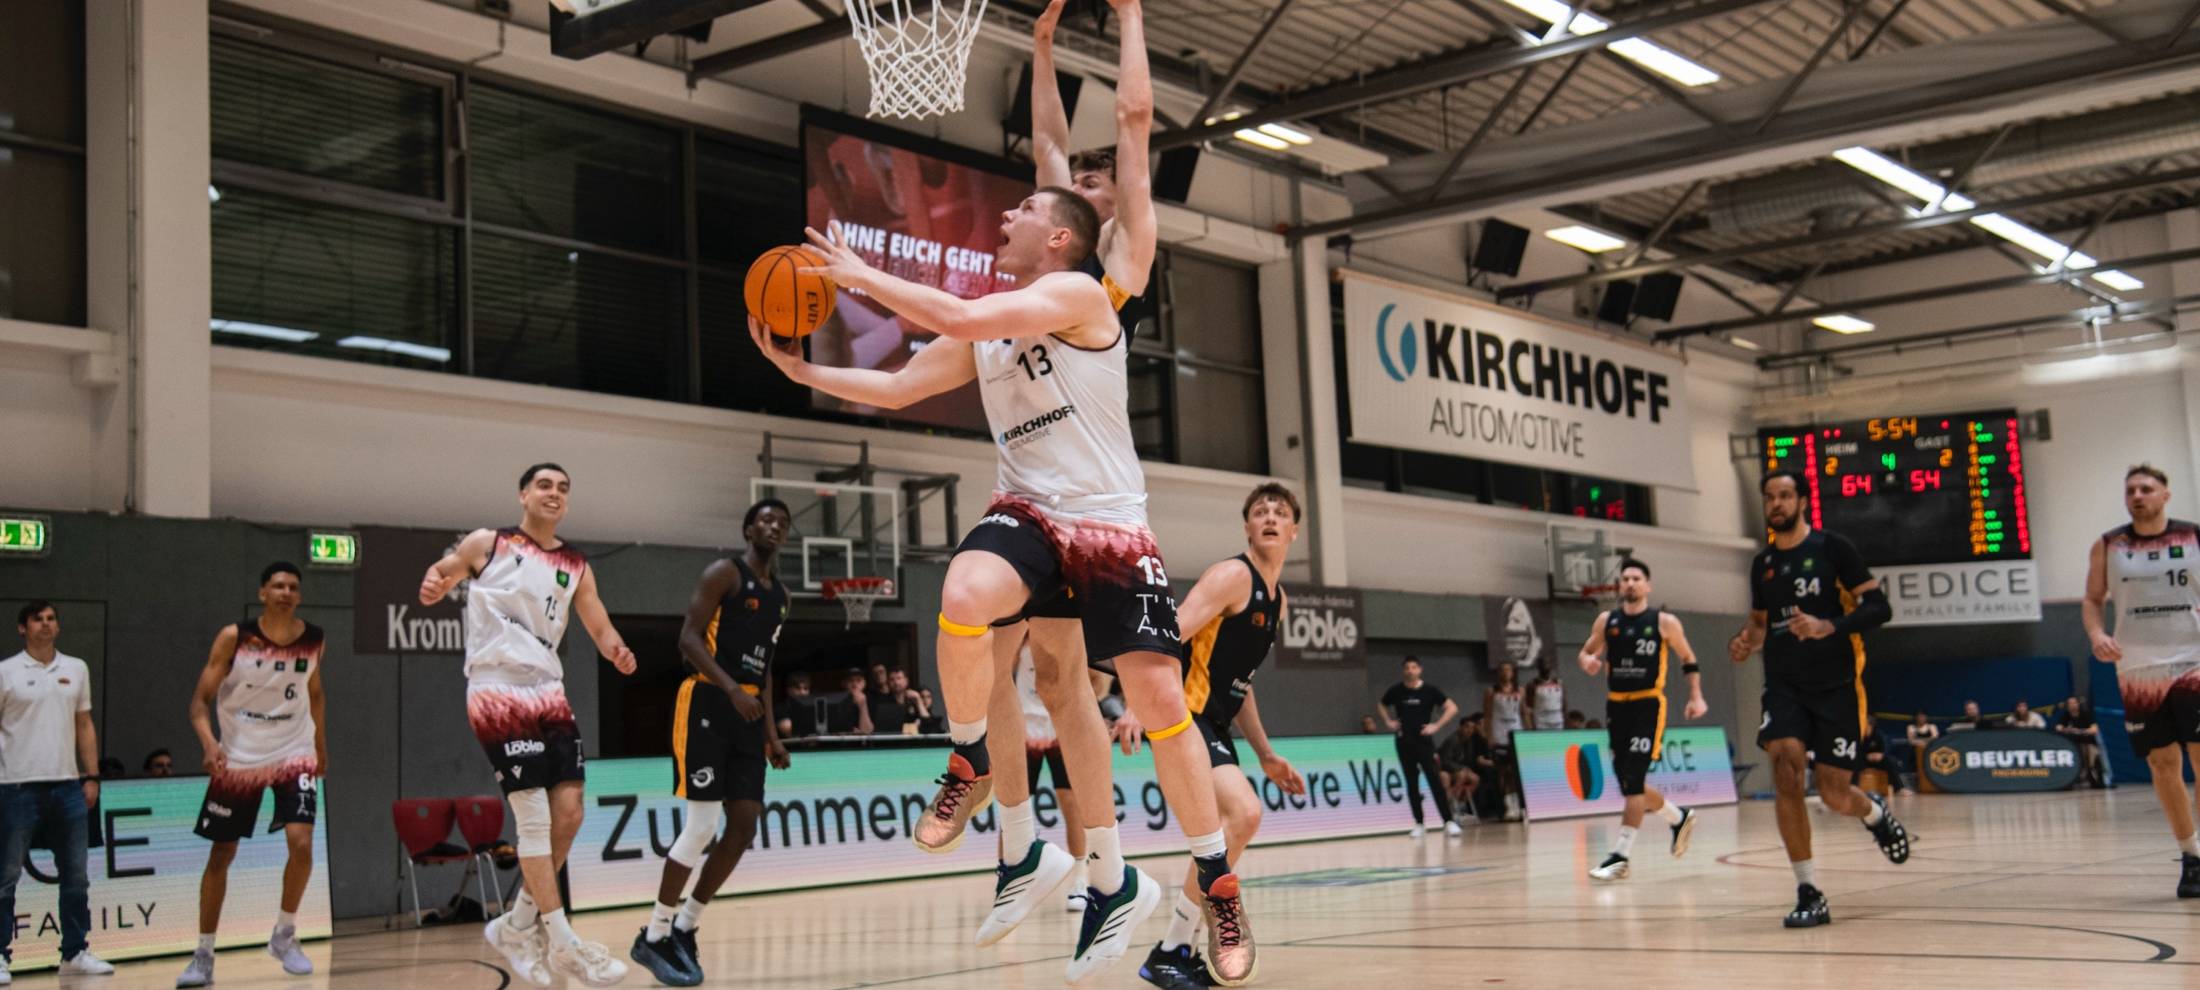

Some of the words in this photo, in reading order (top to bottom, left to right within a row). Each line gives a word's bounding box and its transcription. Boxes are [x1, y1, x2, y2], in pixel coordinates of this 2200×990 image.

[890, 232, 942, 266] EUCH
[945, 246, 994, 276] GEHT
[1016, 344, 1053, 381] 13
[1423, 318, 1670, 424] KIRCHHOFF
[1430, 397, 1586, 459] AUTOMOTIVE
[1825, 442, 1858, 455] HEIM
[1914, 435, 1950, 449] GAST
[1825, 456, 1838, 476] 2
[1881, 452, 1896, 470] 4
[1939, 448, 1953, 467] 2
[1841, 474, 1872, 497] 64
[1910, 469, 1941, 492] 54
[1136, 555, 1169, 587] 13
[2165, 568, 2189, 586] 16
[1794, 577, 1821, 597] 34
[1974, 602, 2032, 614] FAMILY
[1636, 639, 1657, 655] 20
[284, 683, 296, 700] 6
[1630, 737, 1651, 753] 20
[1832, 736, 1857, 760] 34
[1966, 750, 2074, 768] BEUTLER
[14, 902, 157, 940] FAILY
